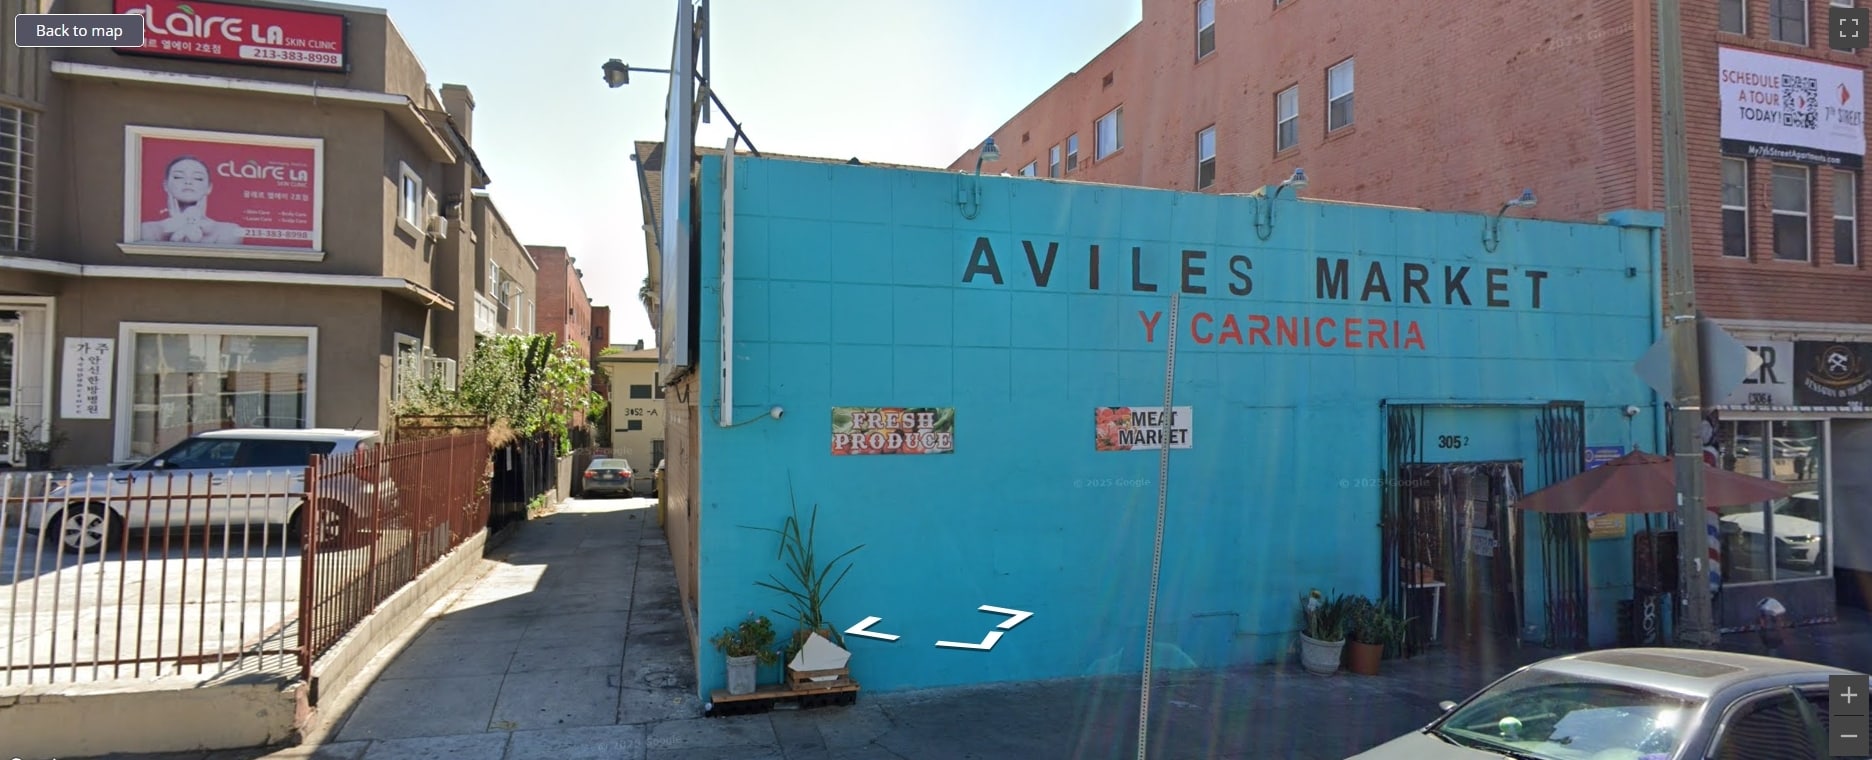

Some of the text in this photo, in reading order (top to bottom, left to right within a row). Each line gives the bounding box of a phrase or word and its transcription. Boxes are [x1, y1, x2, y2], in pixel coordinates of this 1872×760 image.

[252, 24, 283, 45] LA
[285, 38, 336, 50] SKIN CLINIC
[253, 49, 338, 64] 213-383-8998
[1722, 69, 1780, 88] SCHEDULE
[1738, 90, 1780, 106] A TOUR
[1739, 107, 1781, 124] TODAY!
[289, 169, 308, 181] LA
[245, 229, 308, 239] 213-383-8998
[962, 237, 1548, 309] AVILES MARKET
[1138, 311, 1426, 350] Y CARNICERIA
[625, 408, 643, 416] 3052
[1131, 411, 1177, 427] MEAT
[852, 412, 935, 429] FRESH
[834, 432, 951, 450] PRODUCE
